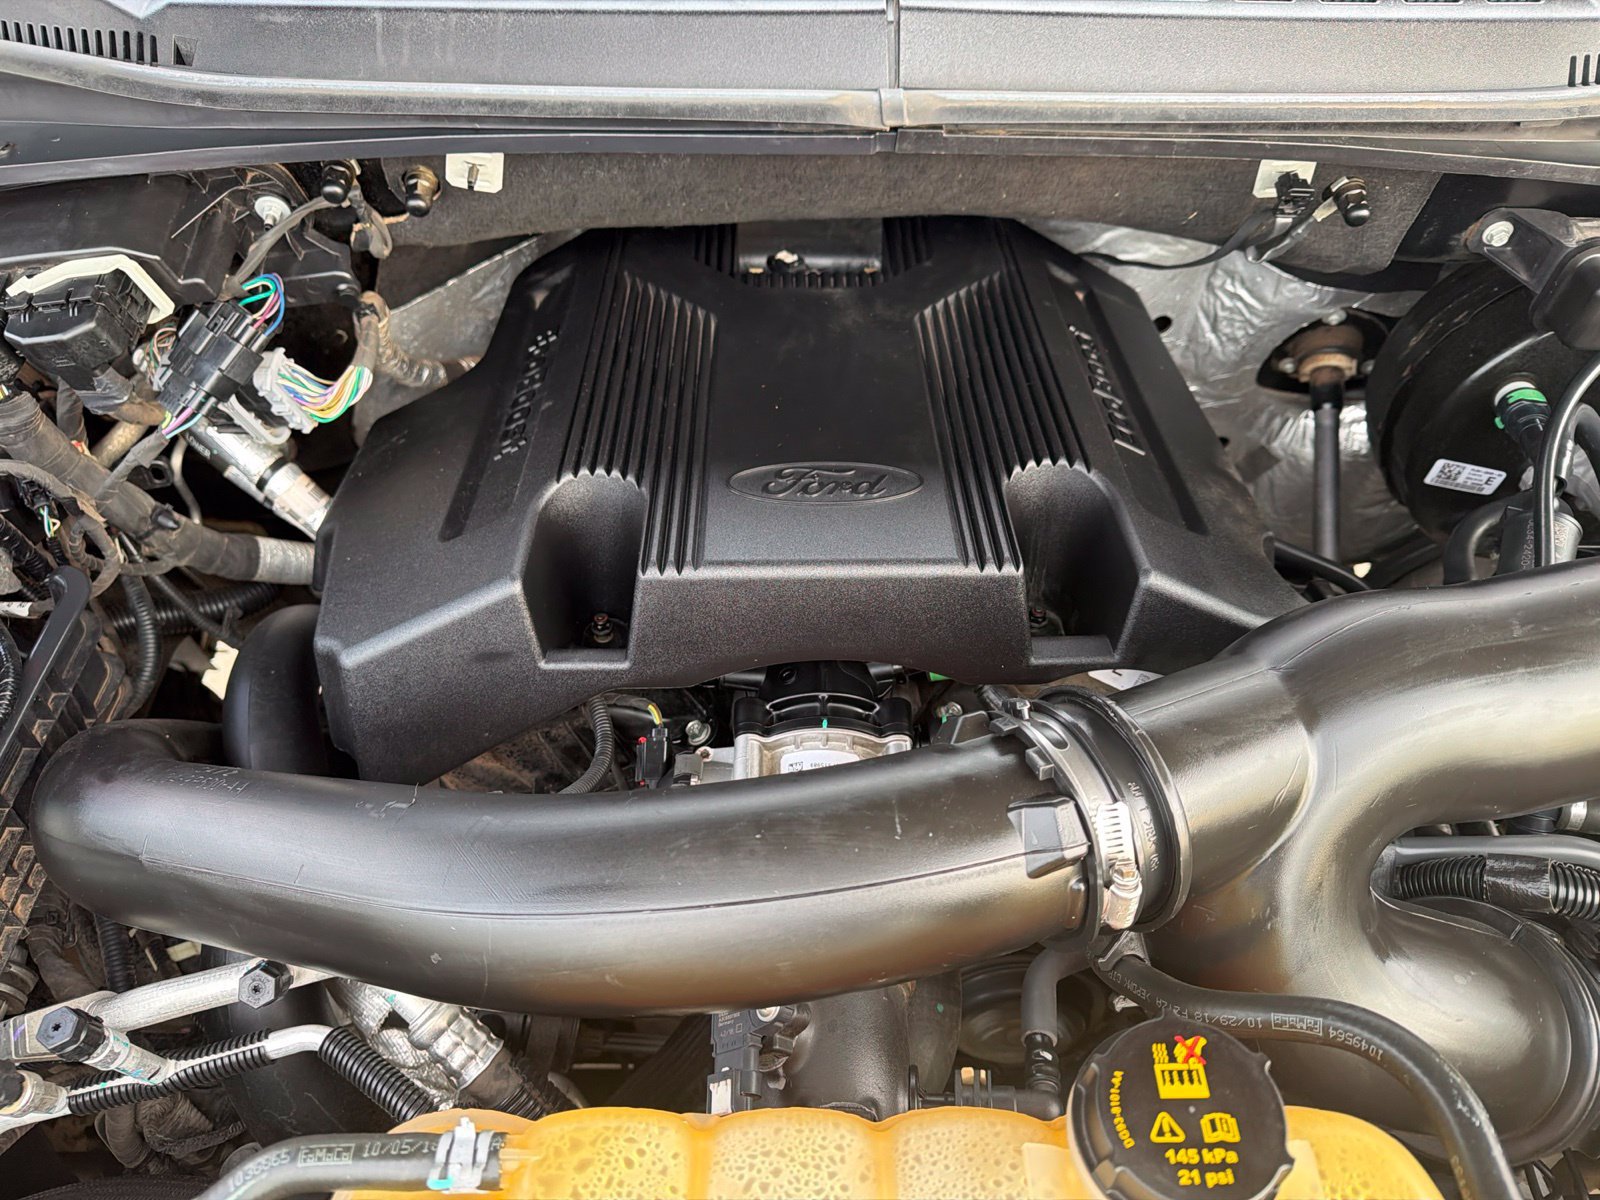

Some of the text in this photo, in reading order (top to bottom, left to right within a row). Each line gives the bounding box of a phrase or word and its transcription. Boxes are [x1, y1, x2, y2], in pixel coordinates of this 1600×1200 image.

[762, 467, 889, 497] Ford
[1484, 476, 1497, 486] E
[1194, 1011, 1263, 1029] 10/29/18
[1273, 1014, 1321, 1034] FoMoCo
[1328, 1026, 1384, 1061] 1049564
[299, 1146, 353, 1165] FoMoCo
[1165, 1147, 1239, 1165] 145 kPa
[1177, 1168, 1235, 1189] 21 psi
